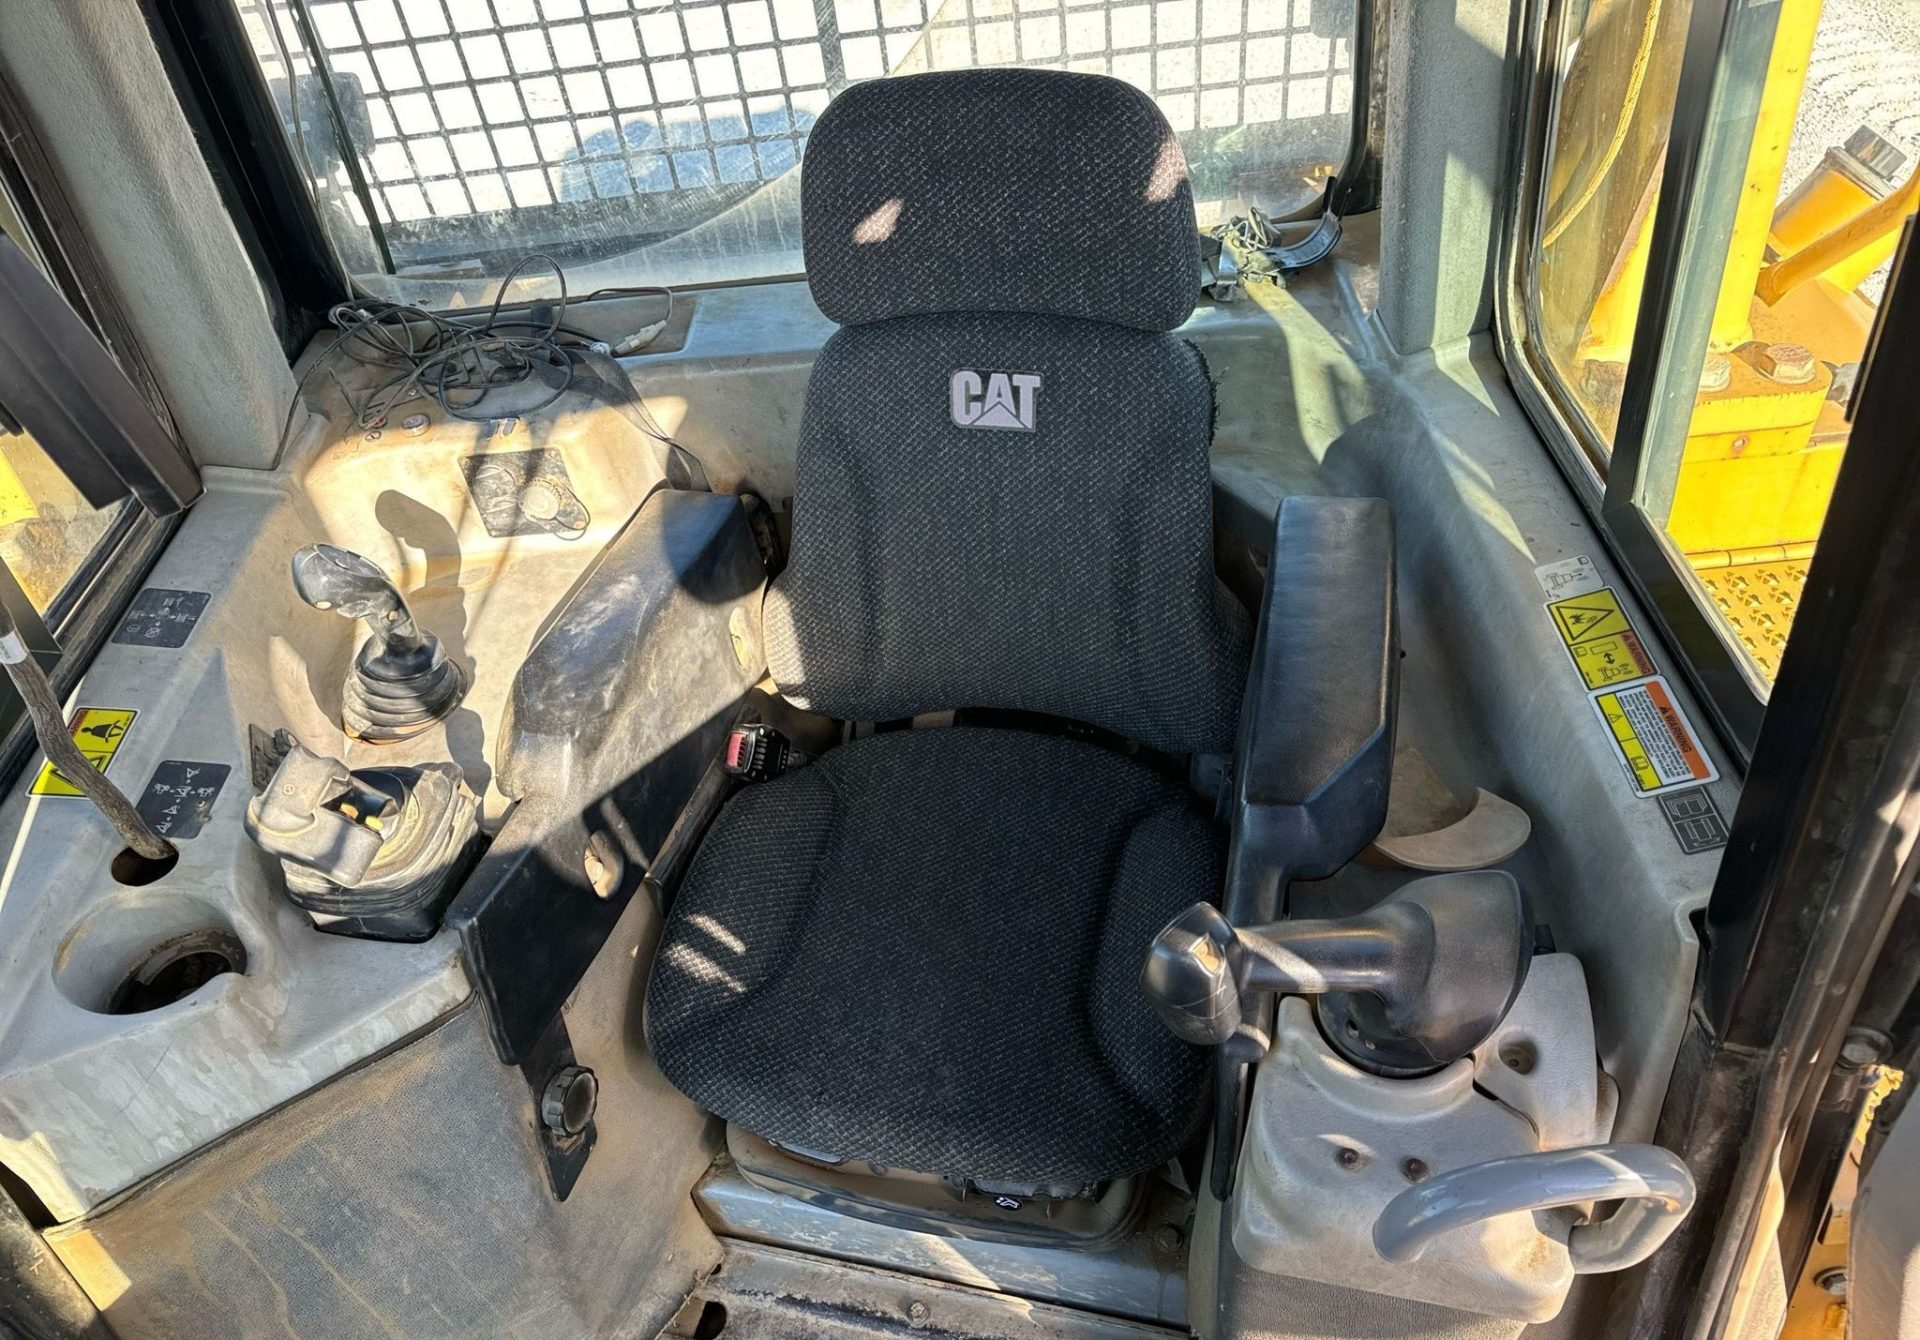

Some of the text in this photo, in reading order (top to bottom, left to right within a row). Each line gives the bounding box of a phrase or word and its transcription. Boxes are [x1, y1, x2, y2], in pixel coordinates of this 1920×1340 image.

[952, 370, 1041, 430] CAT
[1627, 640, 1651, 674] WARNING
[1665, 714, 1693, 753] WARNING
